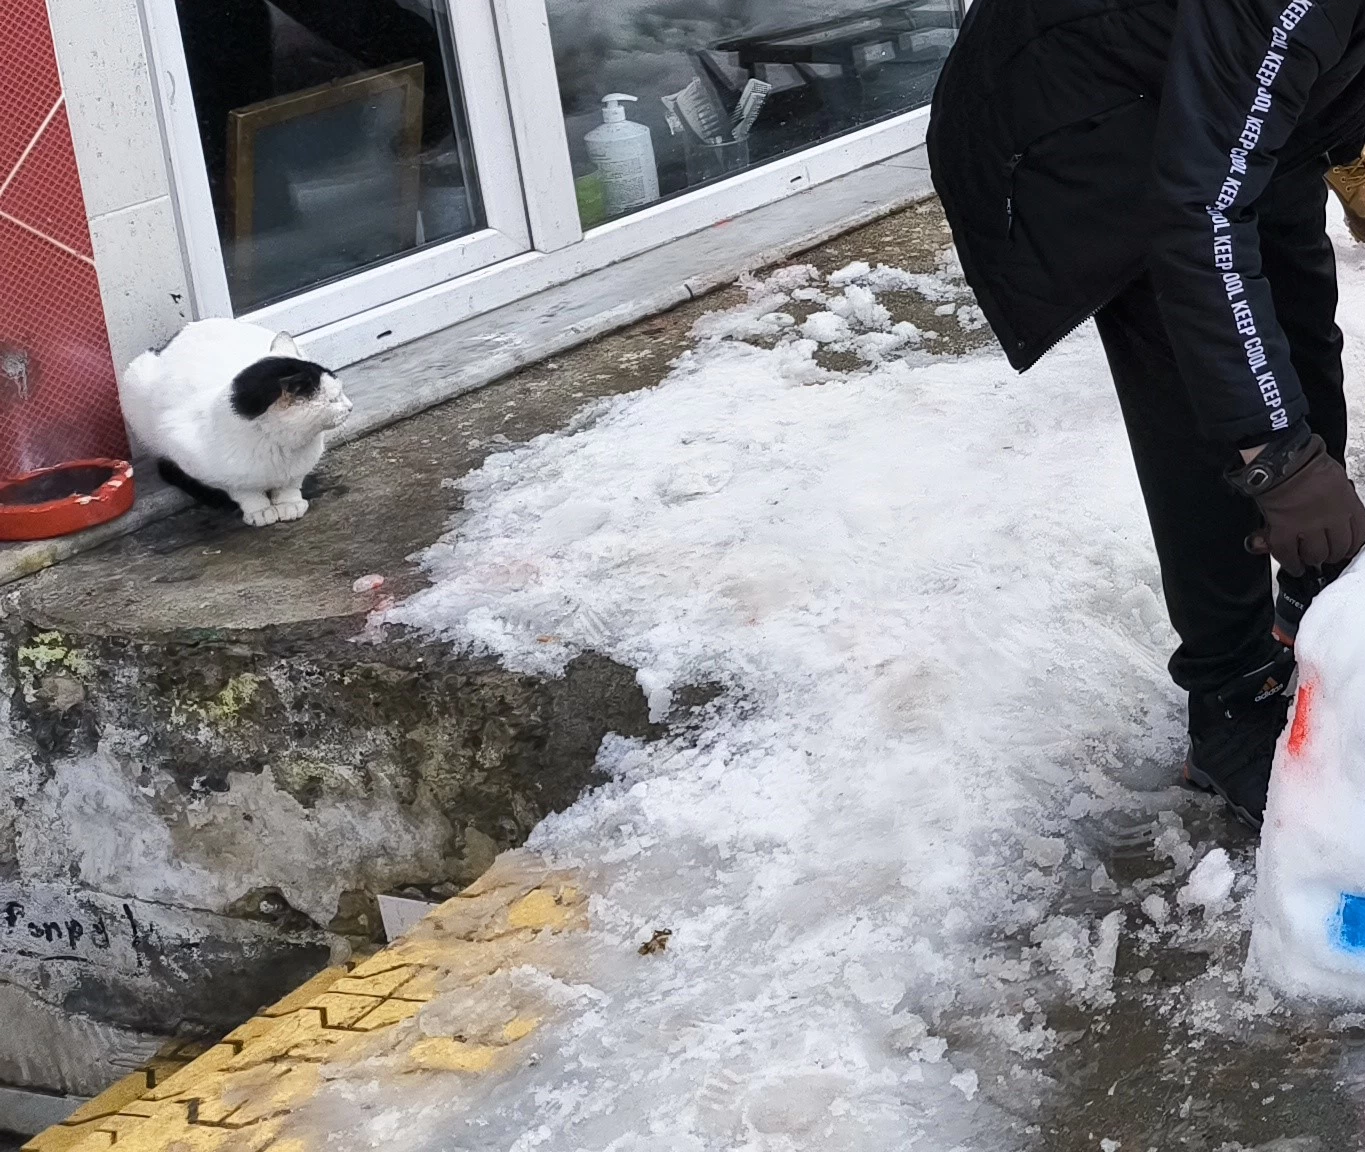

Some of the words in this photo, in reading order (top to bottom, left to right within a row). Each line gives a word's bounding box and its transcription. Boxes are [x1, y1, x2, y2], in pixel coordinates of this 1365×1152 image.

[1255, 50, 1285, 87] KEEP
[1238, 114, 1264, 150] KEEP
[1215, 176, 1242, 212] KEEP
[1213, 234, 1234, 271] KEEP
[1230, 299, 1257, 336] KEEP
[1243, 336, 1268, 374] COOL
[1255, 370, 1282, 409] KEEP
[1254, 683, 1284, 703] adidas
